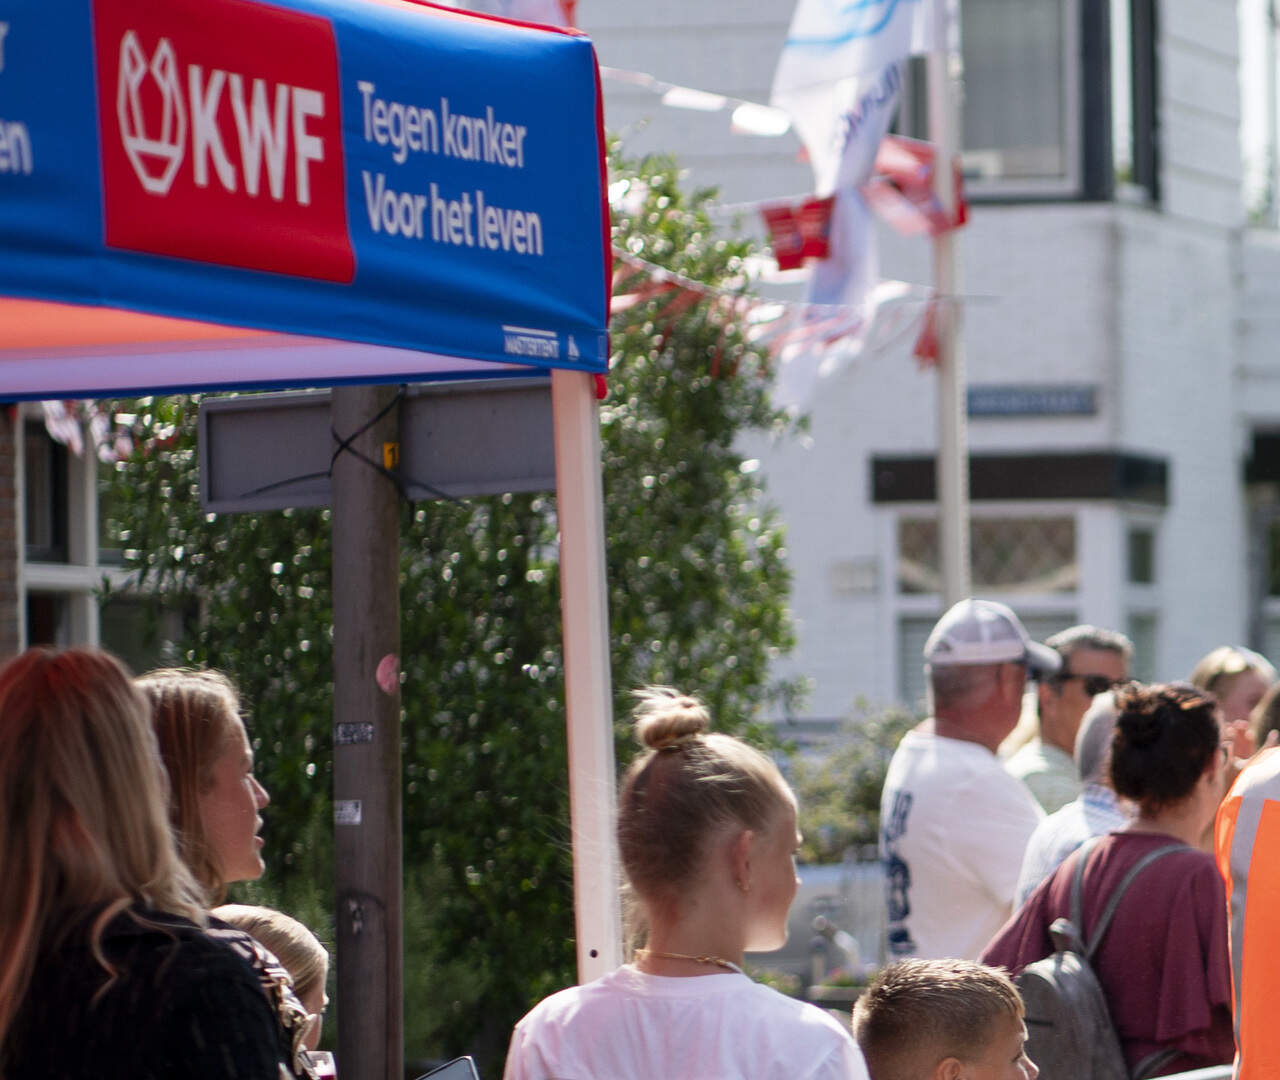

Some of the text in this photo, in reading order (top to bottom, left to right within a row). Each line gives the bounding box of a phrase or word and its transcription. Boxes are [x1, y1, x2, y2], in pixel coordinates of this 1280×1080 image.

[187, 64, 325, 206] KWF
[357, 80, 527, 167] Tegen kanker
[362, 170, 543, 255] Voor het leven
